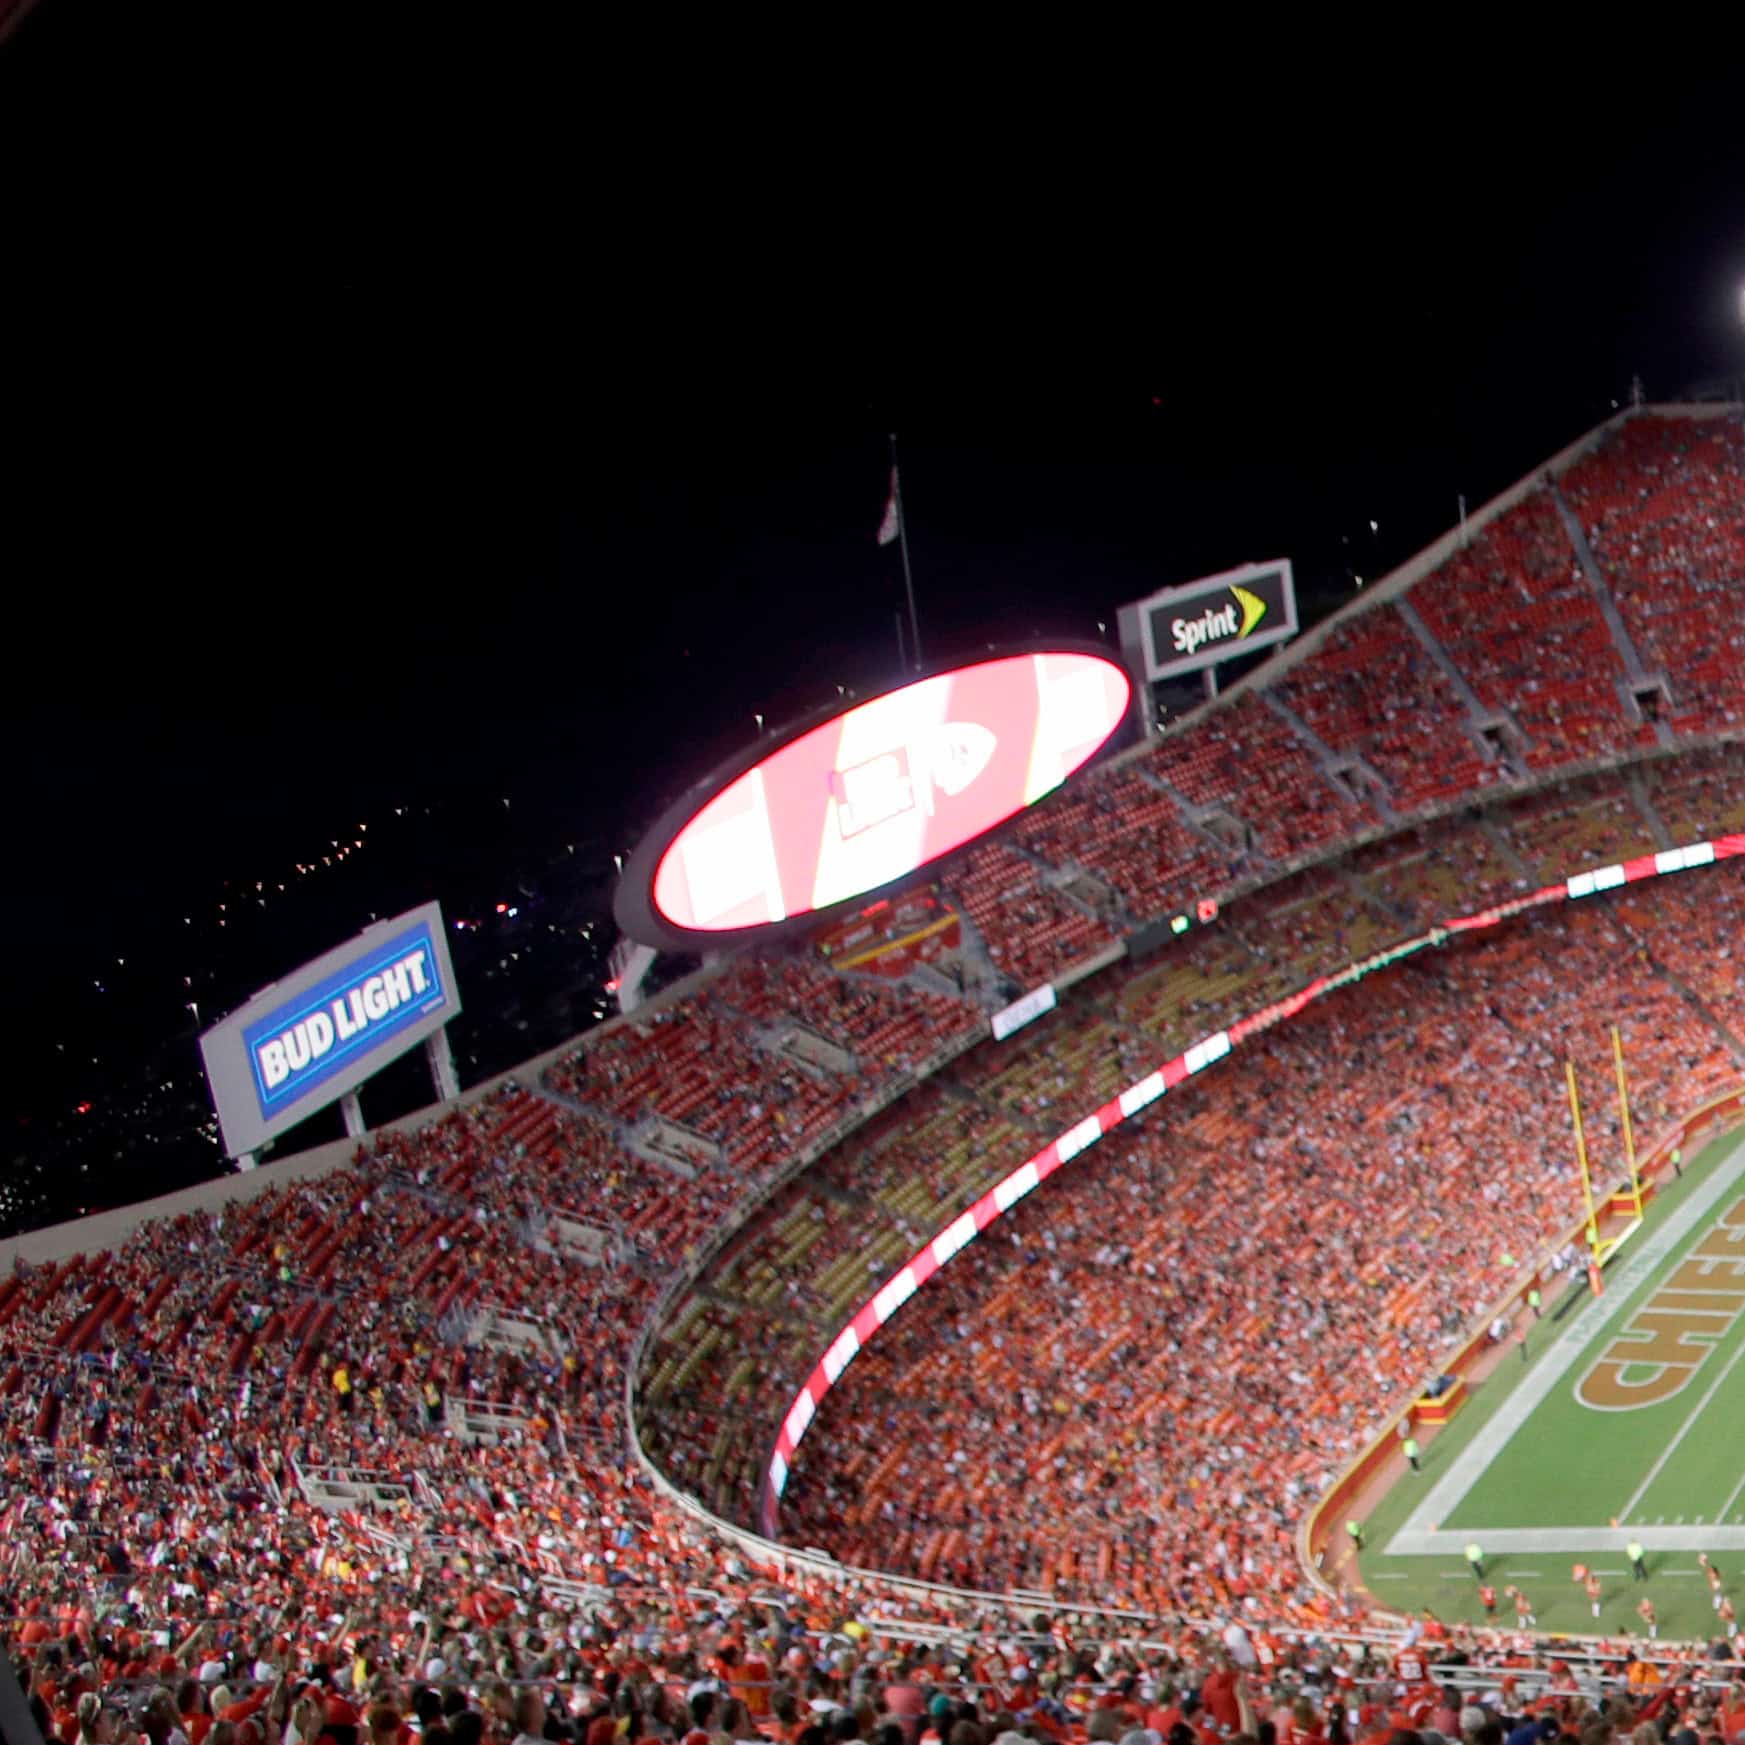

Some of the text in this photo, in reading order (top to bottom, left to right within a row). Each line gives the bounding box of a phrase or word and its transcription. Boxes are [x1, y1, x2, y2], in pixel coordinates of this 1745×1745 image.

[1171, 603, 1239, 655] Sprint
[256, 950, 426, 1089] BUD LIGHT
